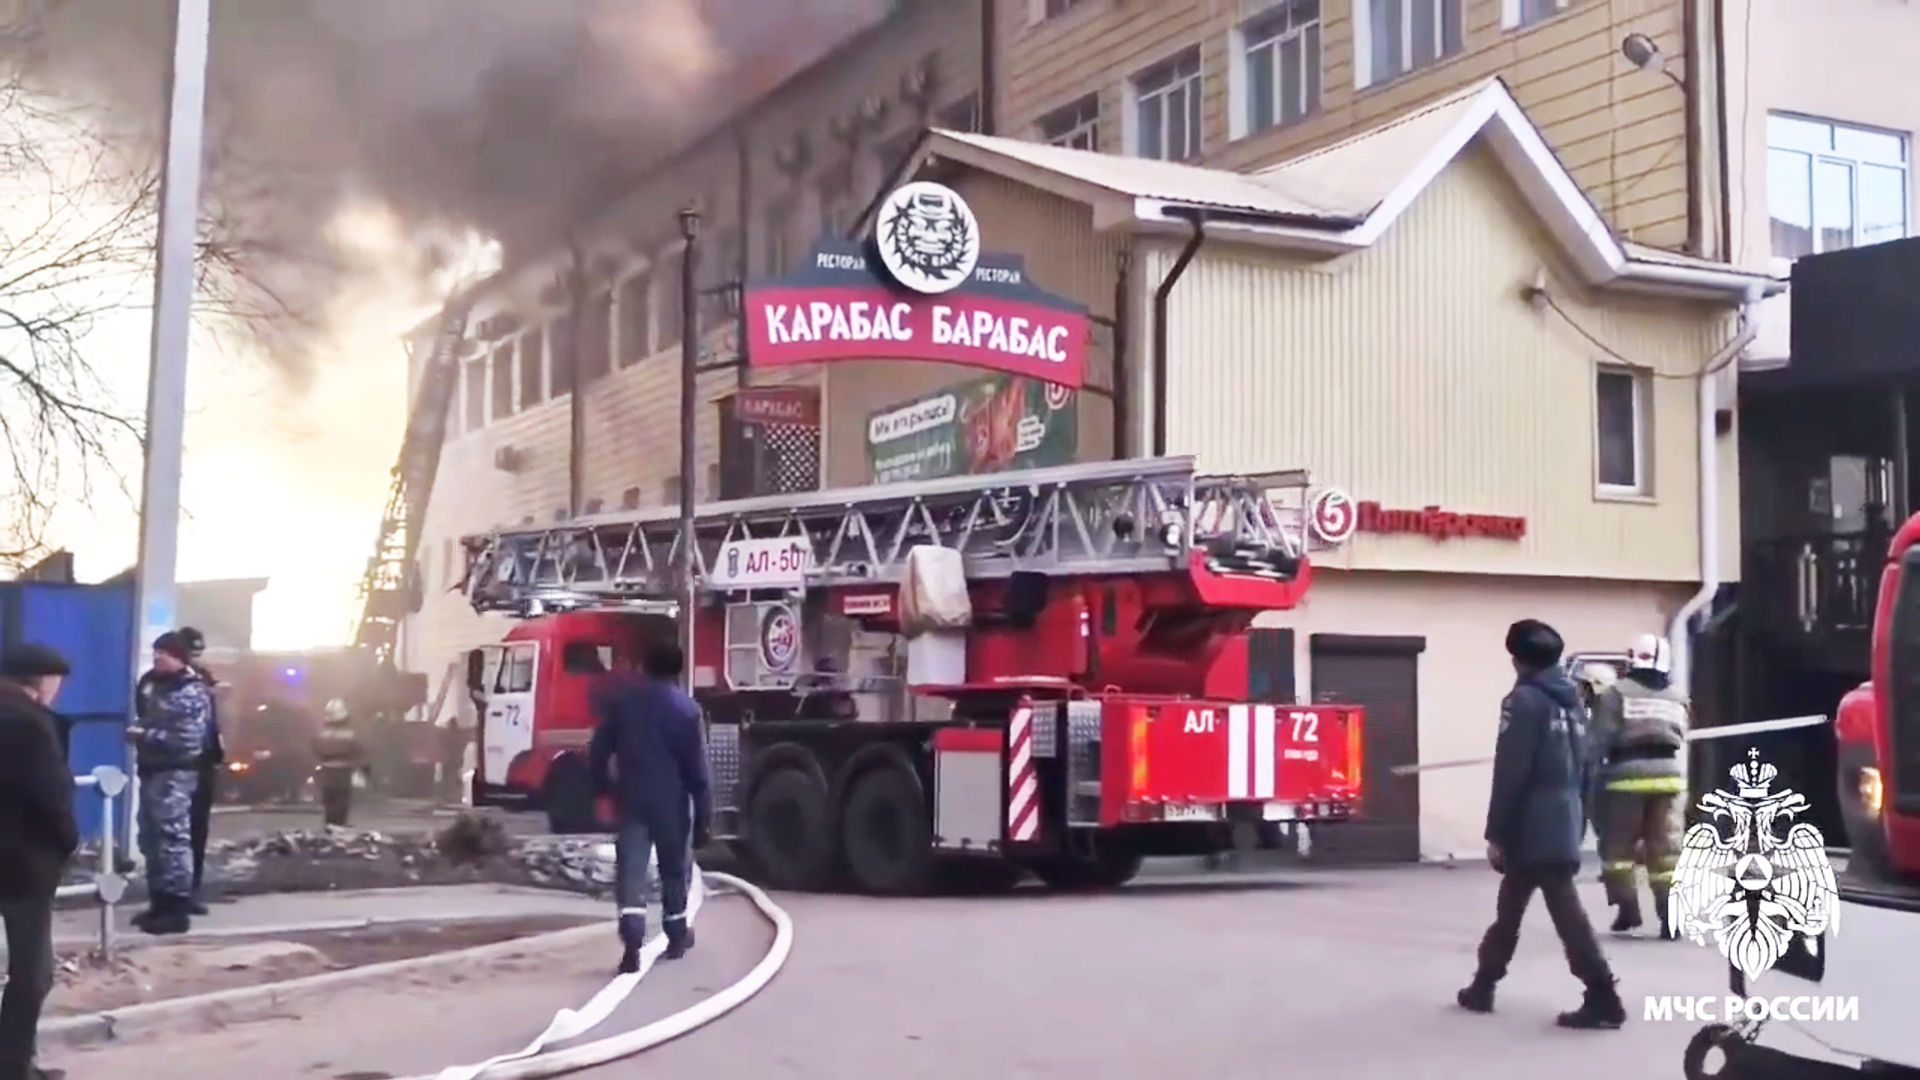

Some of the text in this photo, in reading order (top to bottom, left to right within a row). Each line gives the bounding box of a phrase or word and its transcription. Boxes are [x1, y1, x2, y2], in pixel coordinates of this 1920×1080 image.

[817, 252, 867, 270] РЕСТОРАН
[975, 267, 1021, 284] РЕСТОРАН
[765, 301, 1068, 362] КАРАБАС БАРАБАС
[1322, 497, 1346, 532] 5
[745, 547, 801, 573] АЛ-50
[506, 704, 520, 726] 72
[1184, 710, 1215, 733] АЛ
[1289, 712, 1319, 742] 72
